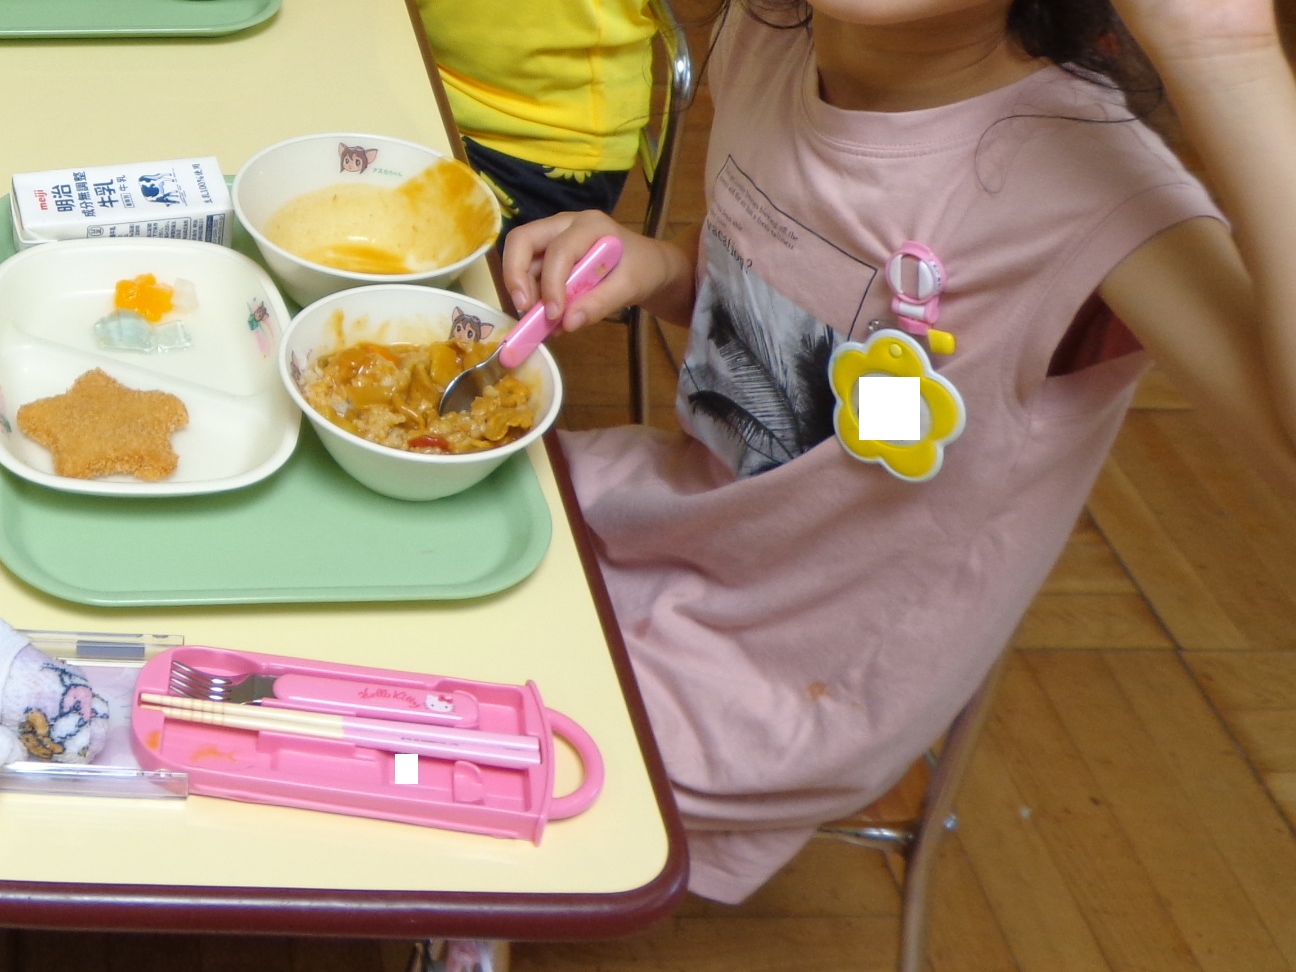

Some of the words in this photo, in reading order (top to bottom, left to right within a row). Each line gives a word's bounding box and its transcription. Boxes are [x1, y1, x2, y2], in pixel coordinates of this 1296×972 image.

[72, 171, 97, 218] 成分無調整
[93, 178, 119, 209] 牛乳
[116, 175, 129, 192] 牛乳
[33, 189, 48, 211] meiji
[50, 184, 76, 213] 明治
